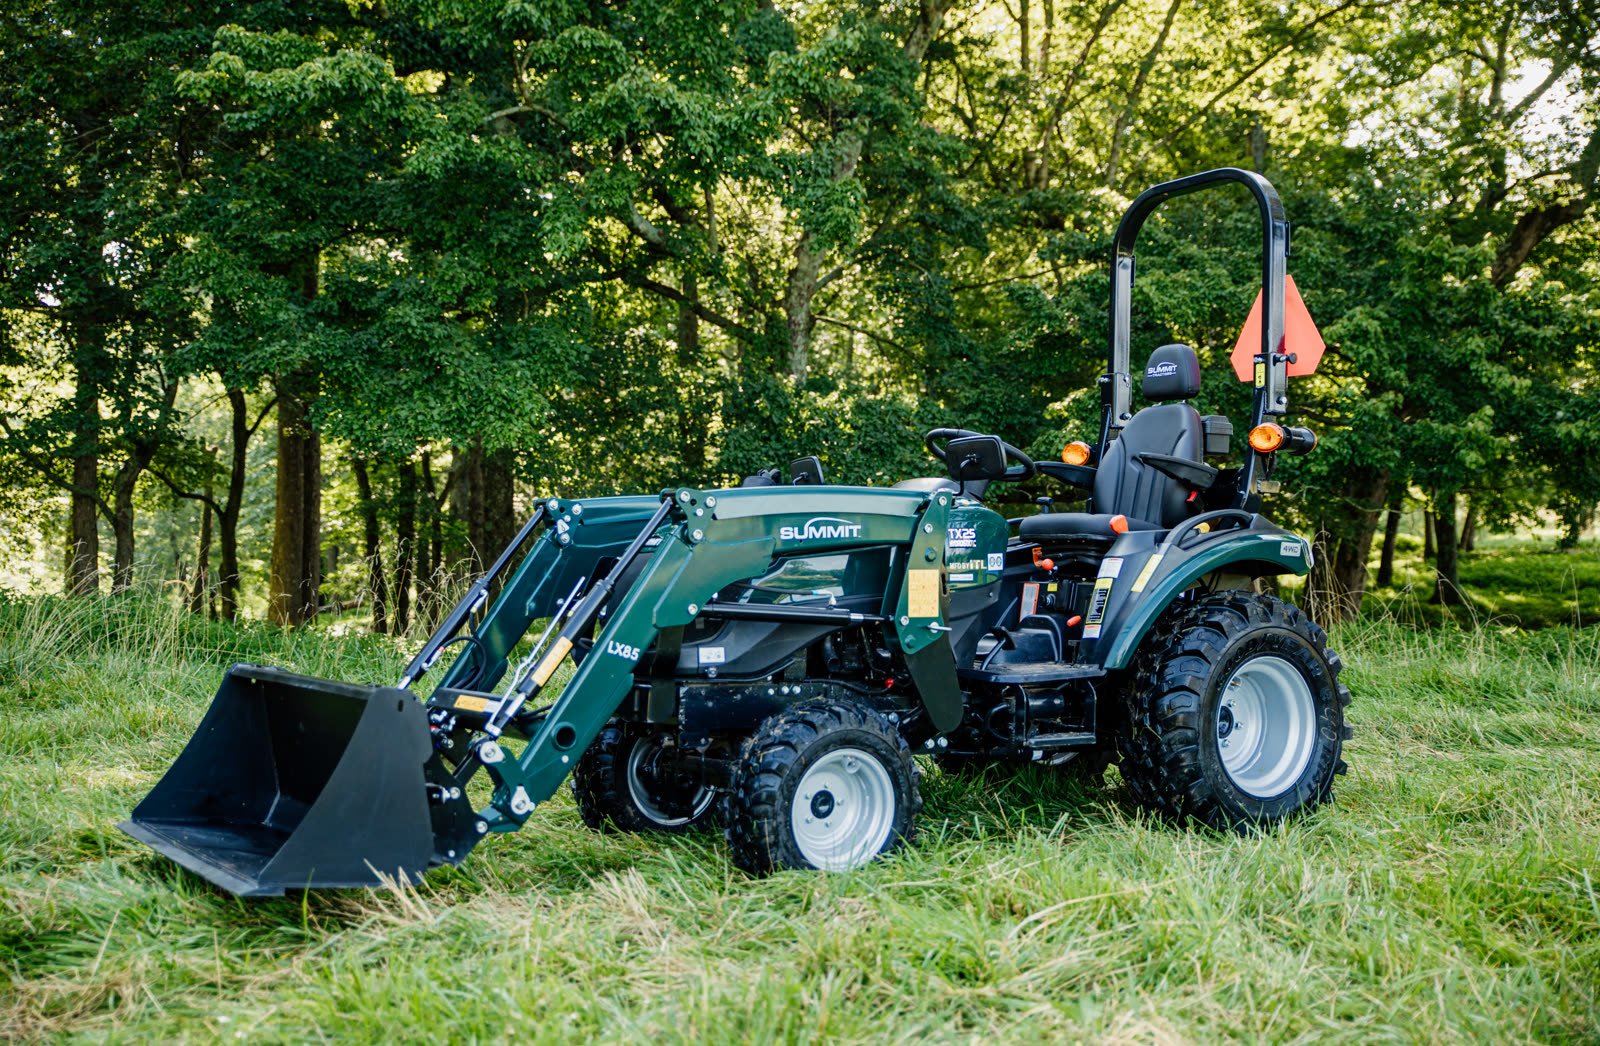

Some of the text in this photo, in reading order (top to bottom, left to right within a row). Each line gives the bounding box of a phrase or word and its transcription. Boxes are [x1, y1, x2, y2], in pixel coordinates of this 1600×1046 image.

[1147, 361, 1177, 375] SUMMIT
[780, 517, 861, 540] SUMMIT
[948, 528, 976, 539] TX25
[1282, 544, 1299, 553] 4WD
[607, 640, 641, 661] LX85
